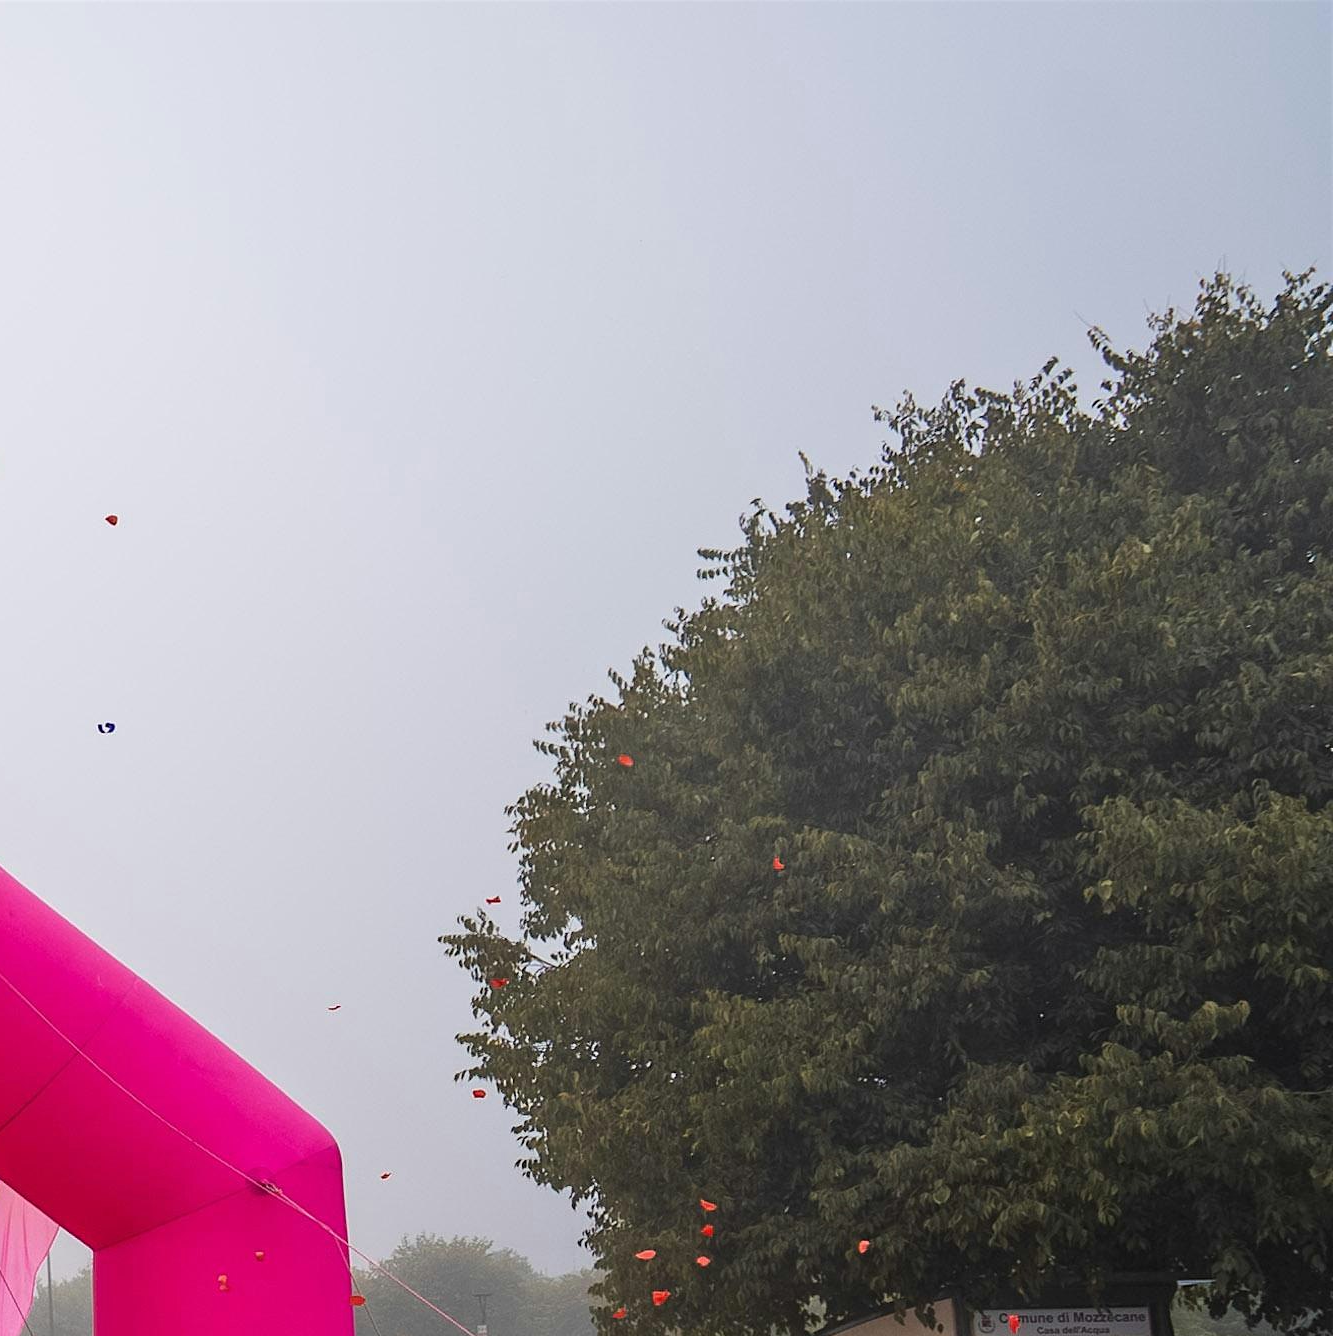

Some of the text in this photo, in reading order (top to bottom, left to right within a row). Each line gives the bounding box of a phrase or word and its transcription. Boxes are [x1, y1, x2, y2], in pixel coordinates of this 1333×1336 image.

[999, 1312, 1054, 1324] Cmune
[1058, 1312, 1070, 1322] di
[1037, 1327, 1060, 1335] Casa
